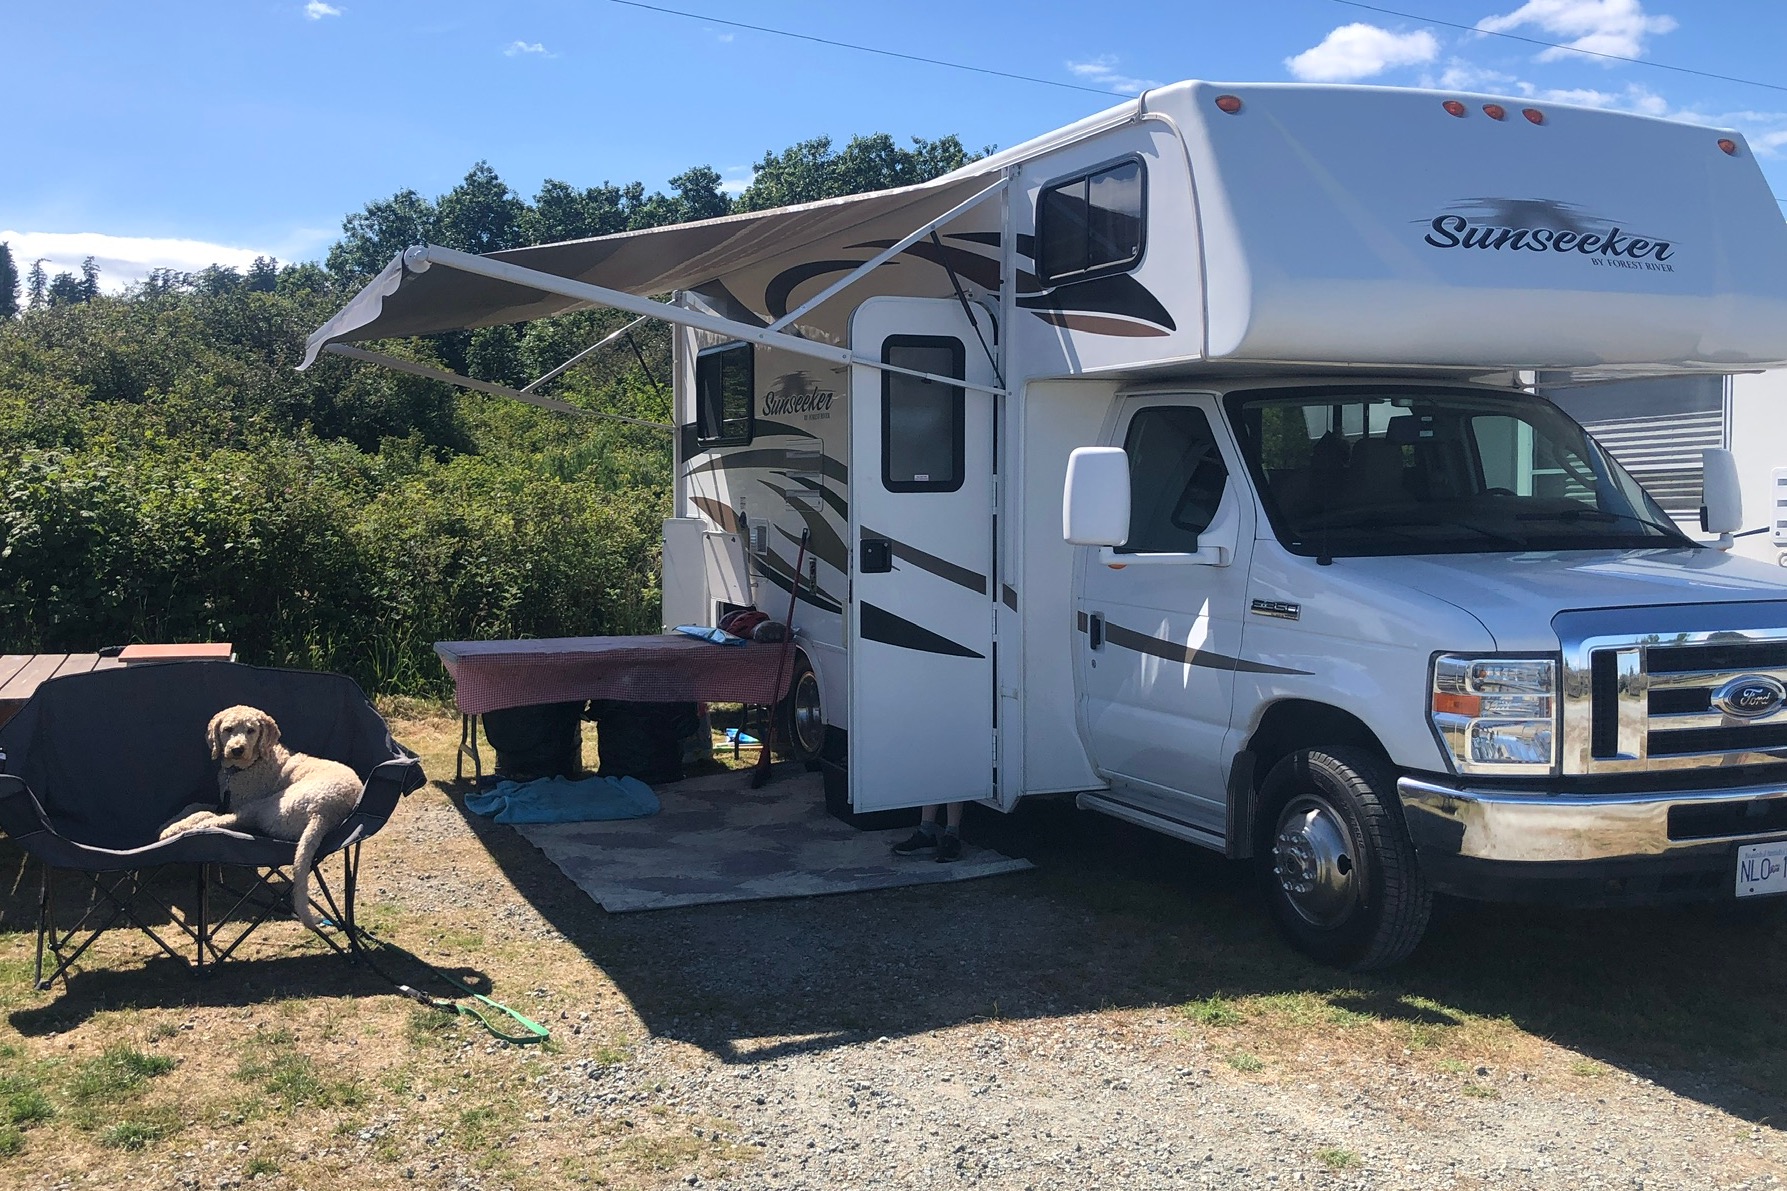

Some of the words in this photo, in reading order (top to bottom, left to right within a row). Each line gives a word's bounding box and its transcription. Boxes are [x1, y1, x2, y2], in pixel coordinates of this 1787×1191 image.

[1424, 214, 1676, 261] Sunseeker
[1591, 257, 1604, 266] BY
[1607, 258, 1643, 270] FOREST
[1644, 261, 1675, 273] RIVER
[762, 386, 834, 416] Sunseeker
[1740, 688, 1771, 706] Ford
